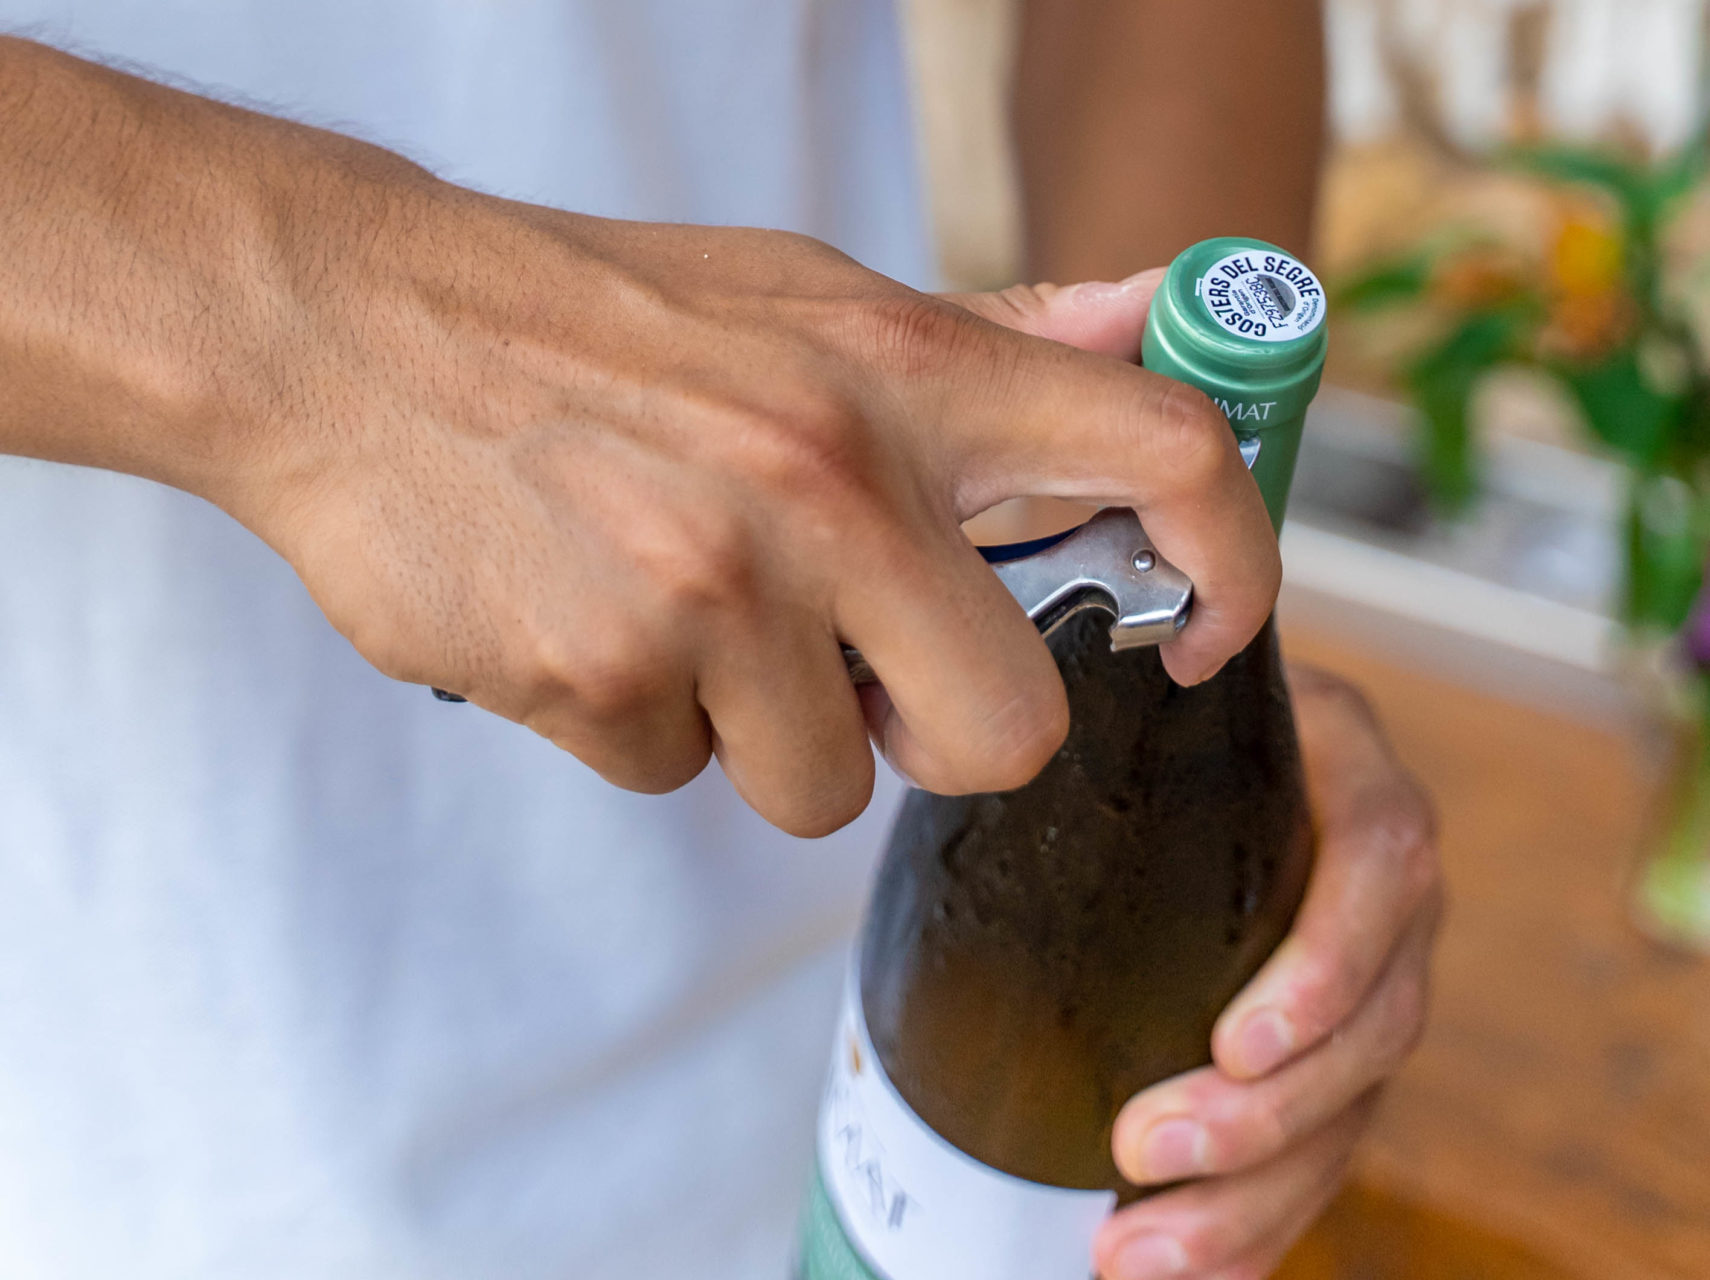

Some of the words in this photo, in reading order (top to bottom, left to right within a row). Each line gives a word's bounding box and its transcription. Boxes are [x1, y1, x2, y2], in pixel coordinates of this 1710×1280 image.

[1219, 256, 1259, 280] DEL
[1263, 256, 1320, 298] SEGRE
[1208, 277, 1267, 337] COSTERS
